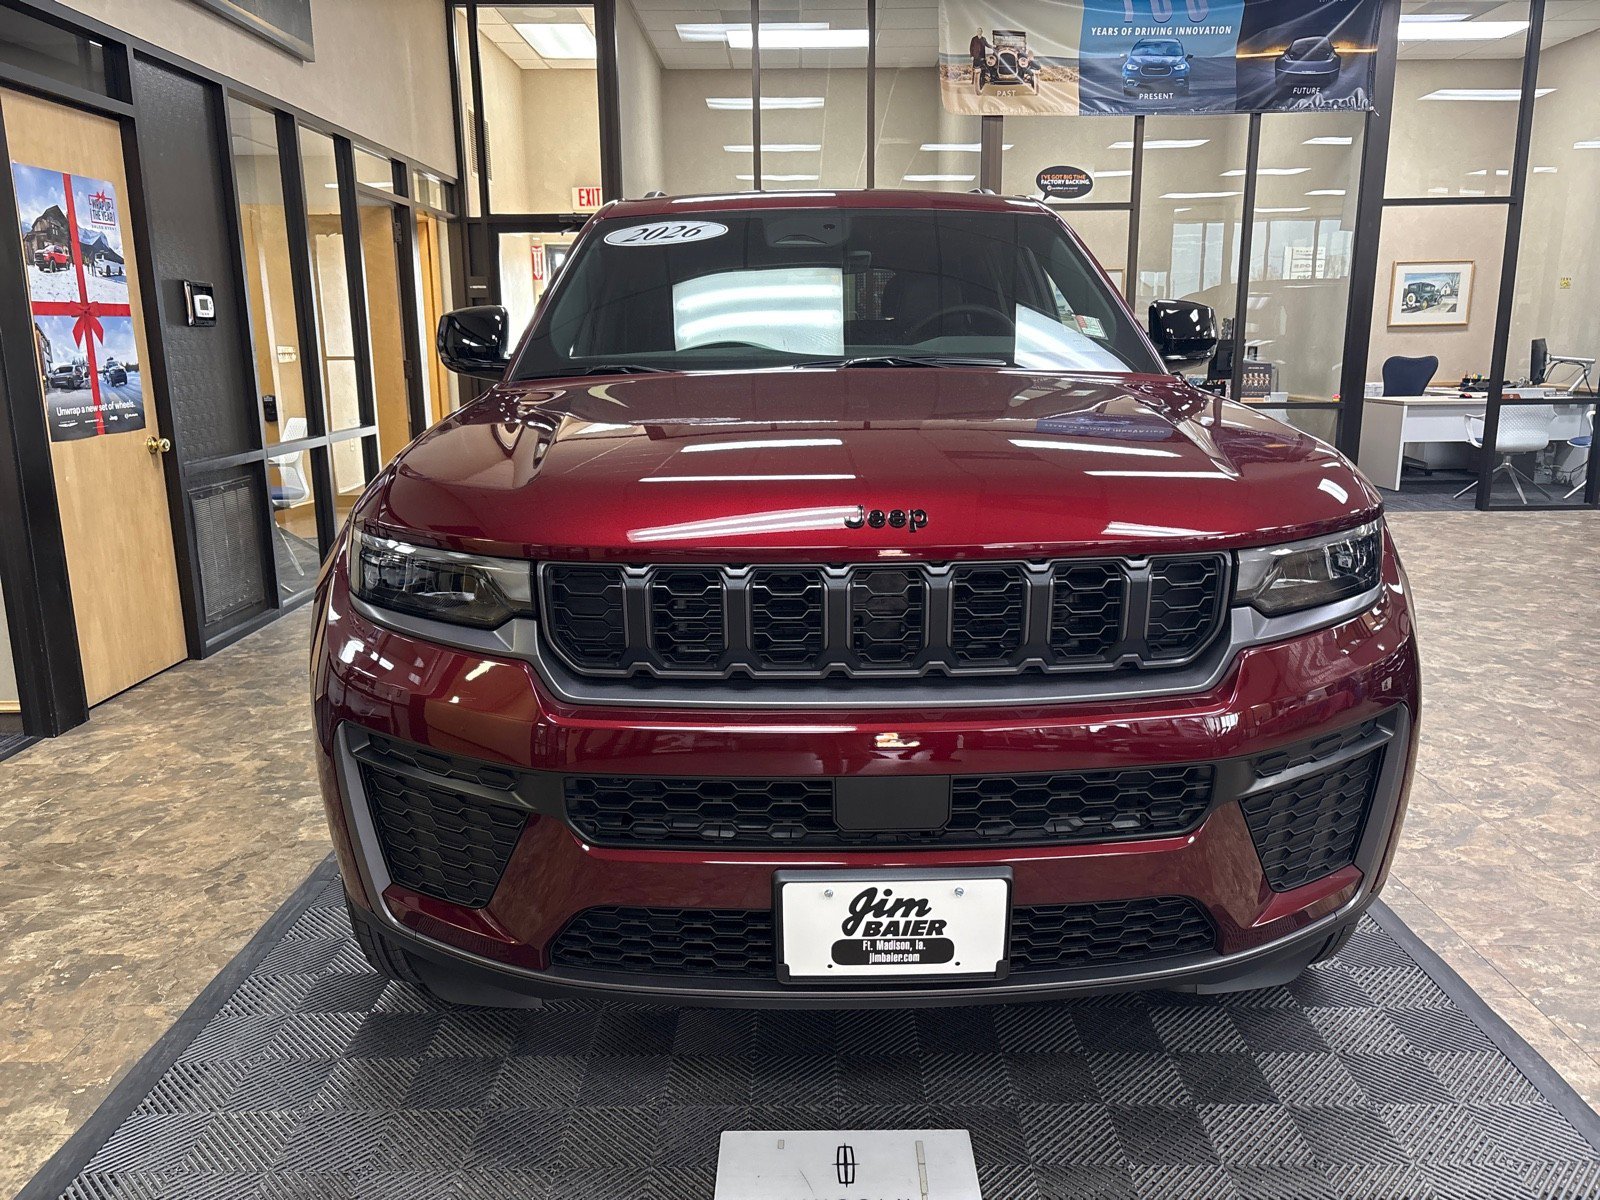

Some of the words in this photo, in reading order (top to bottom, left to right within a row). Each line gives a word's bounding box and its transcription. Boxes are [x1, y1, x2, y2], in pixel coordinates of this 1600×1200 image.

[1091, 27, 1118, 36] YEARS
[1121, 27, 1132, 36] OF
[1135, 26, 1172, 36] DRIVING
[1175, 25, 1232, 35] INNOVATION
[1139, 92, 1174, 100] PRESENT
[578, 188, 601, 207] EXIT
[92, 199, 105, 211] WRAP
[105, 201, 111, 211] UP
[92, 210, 102, 220] THE
[101, 211, 113, 222] YEAR
[622, 225, 707, 242] 2026
[56, 407, 81, 416] Unwrap
[99, 403, 108, 411] set
[108, 401, 114, 410] of
[844, 504, 929, 533] Jeep
[842, 887, 932, 937] Jim
[862, 920, 948, 937] BAIER
[863, 941, 873, 951] Ft.
[876, 940, 912, 951] Madison,
[916, 940, 926, 950] Ia.
[869, 953, 920, 964] jimbaier.com
